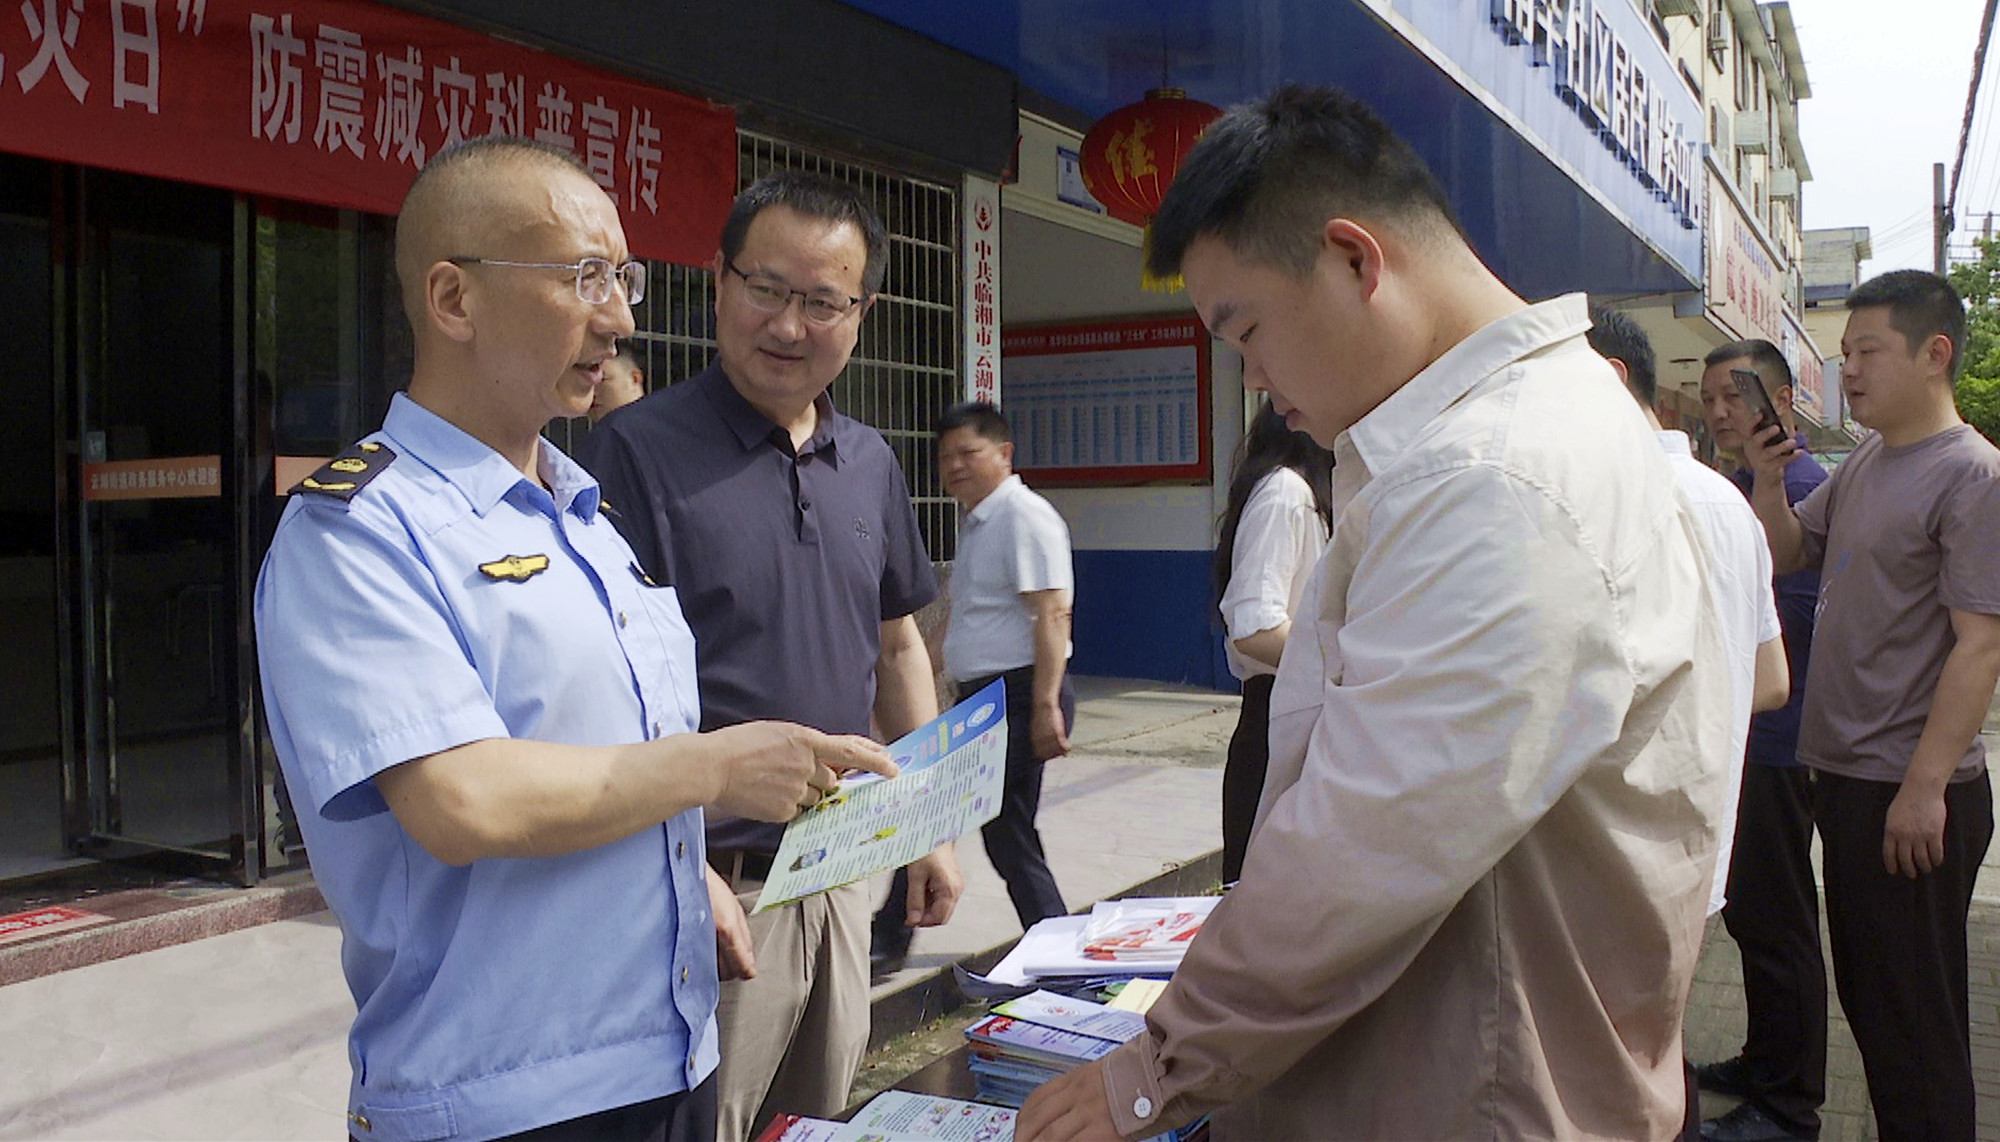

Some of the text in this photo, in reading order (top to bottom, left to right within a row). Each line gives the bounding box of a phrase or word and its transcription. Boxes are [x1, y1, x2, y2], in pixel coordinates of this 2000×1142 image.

[0, 0, 662, 216] 灾日” 防震减灾科普宣传
[1502, 0, 1702, 222] 社区居民服务中心
